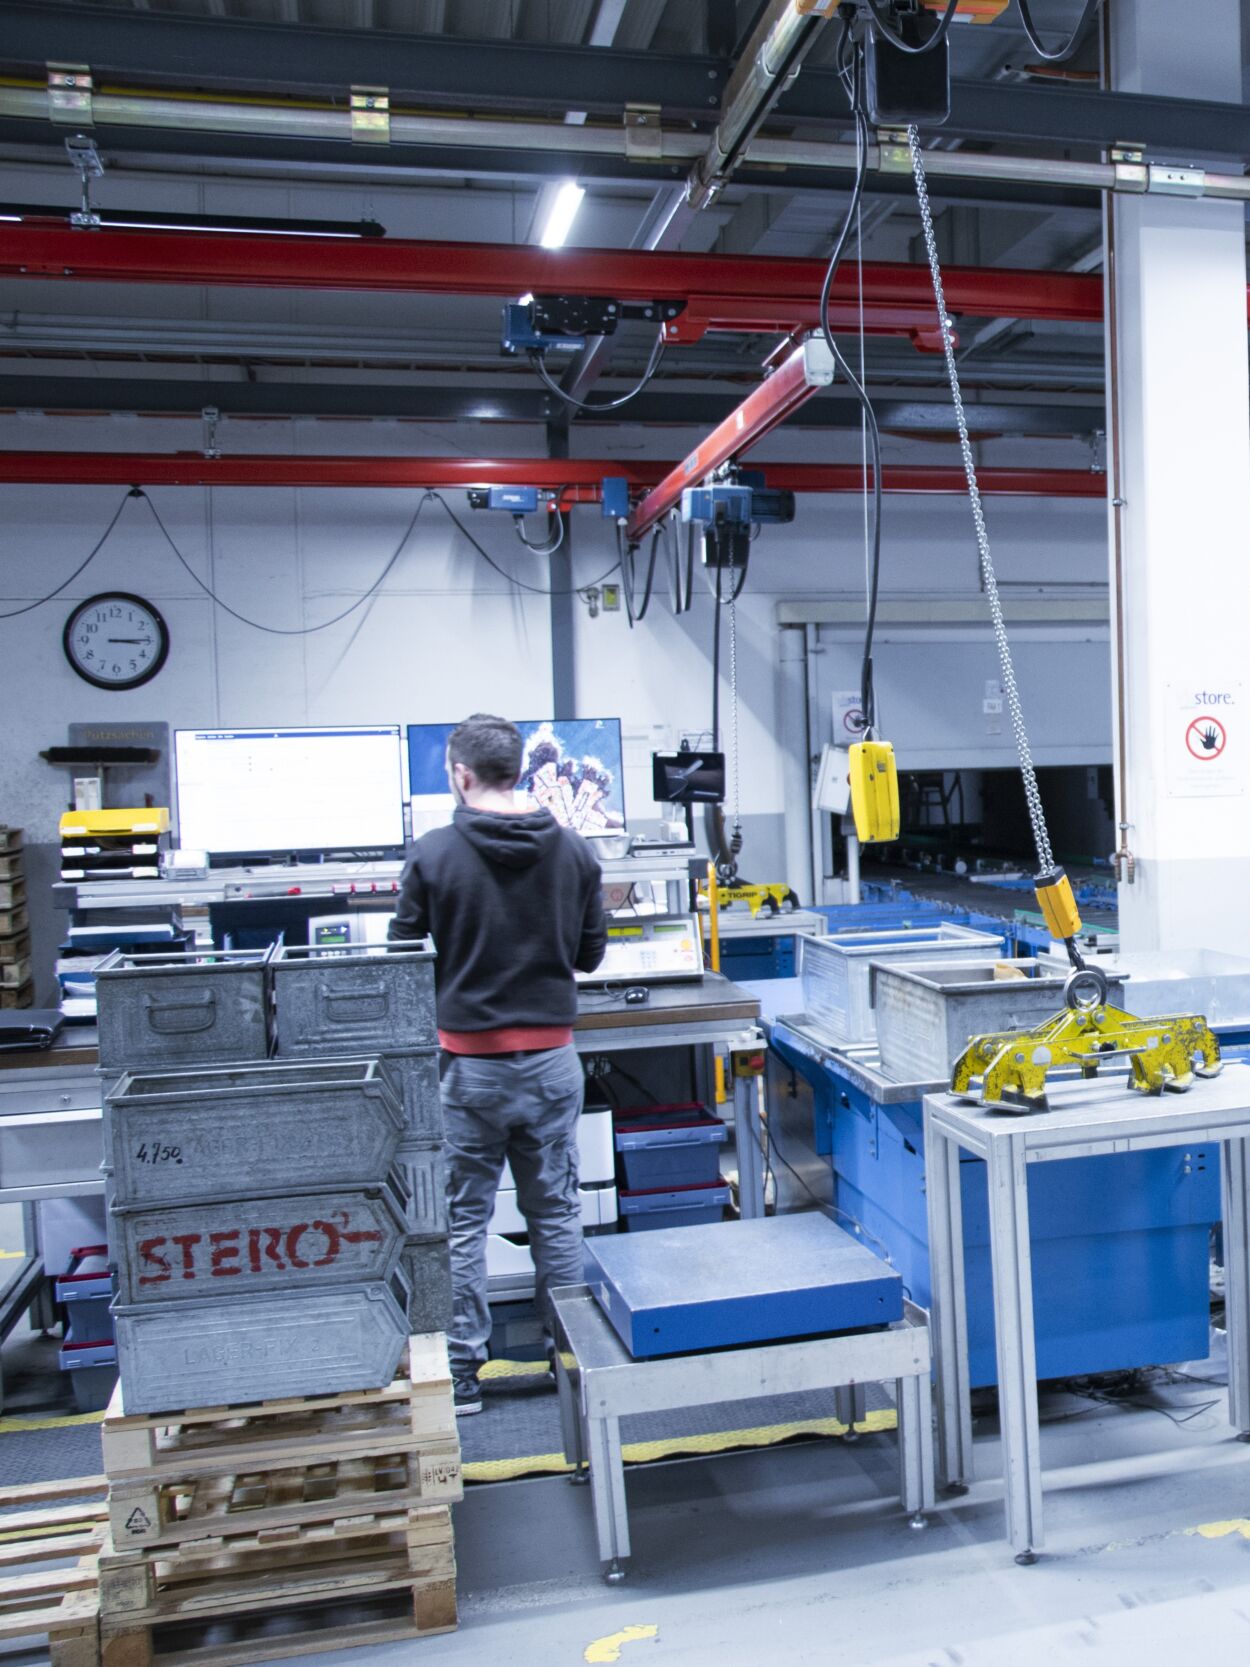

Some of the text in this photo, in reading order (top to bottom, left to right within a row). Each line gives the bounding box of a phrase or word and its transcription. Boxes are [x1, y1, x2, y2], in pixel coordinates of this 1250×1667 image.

[96, 612, 107, 623] 11
[109, 608, 122, 618] 12
[86, 623, 98, 634] 10
[137, 621, 145, 631] 2
[80, 636, 89, 646] 9
[144, 635, 151, 645] 3
[86, 650, 94, 660] 8
[139, 650, 147, 659] 4
[100, 660, 106, 670] 7
[112, 664, 121, 674] 6
[129, 660, 137, 670] 5
[1195, 691, 1235, 705] store.
[184, 1335, 298, 1366] LAGER-FIX
